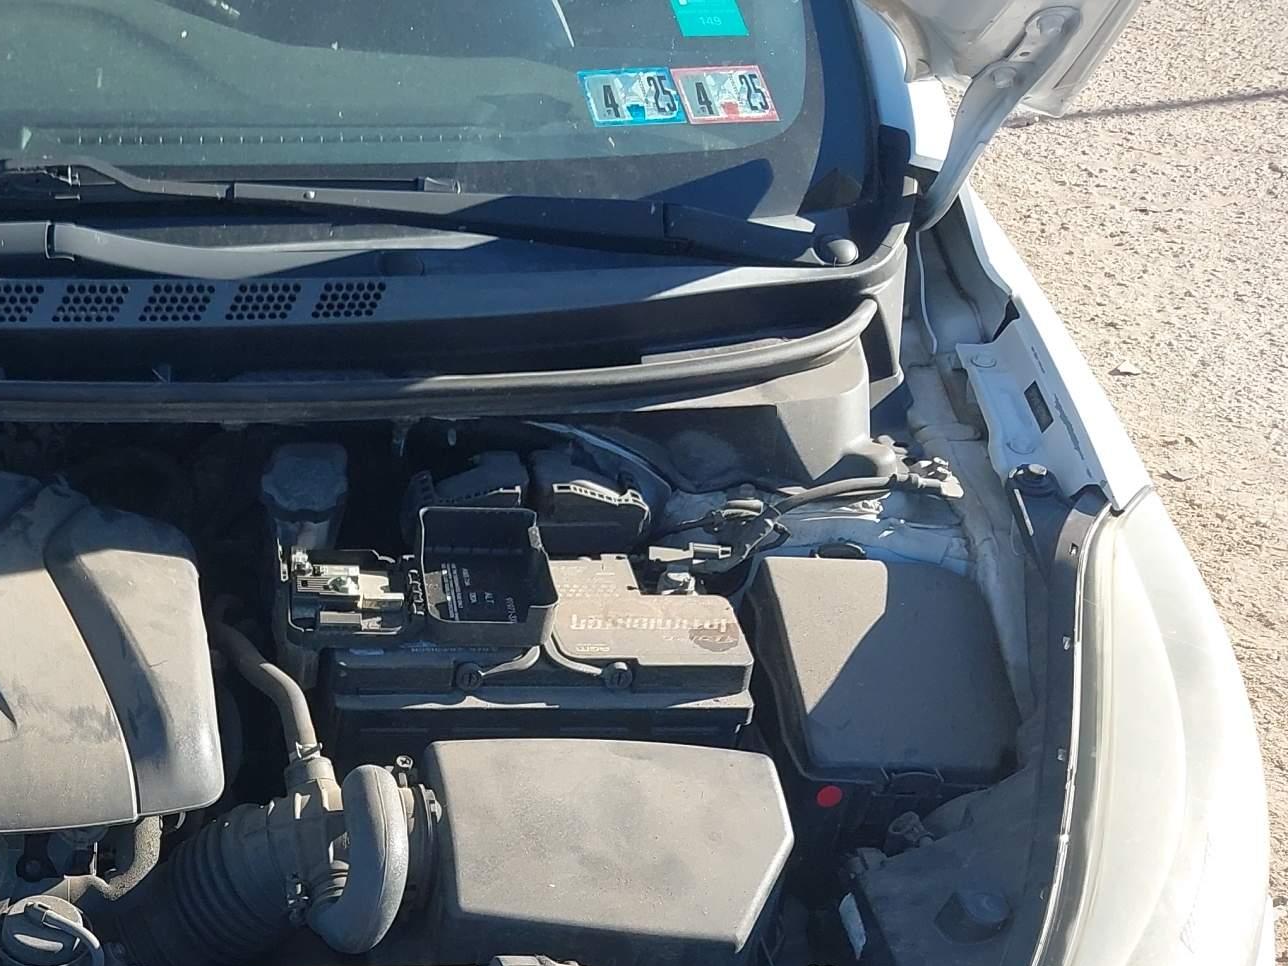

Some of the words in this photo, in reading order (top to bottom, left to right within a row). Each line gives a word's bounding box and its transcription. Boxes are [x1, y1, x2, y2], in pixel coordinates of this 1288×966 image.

[698, 15, 723, 27] 149
[603, 85, 621, 118] 4
[646, 75, 677, 112] 25
[695, 81, 715, 115] 4
[738, 73, 770, 111] 25
